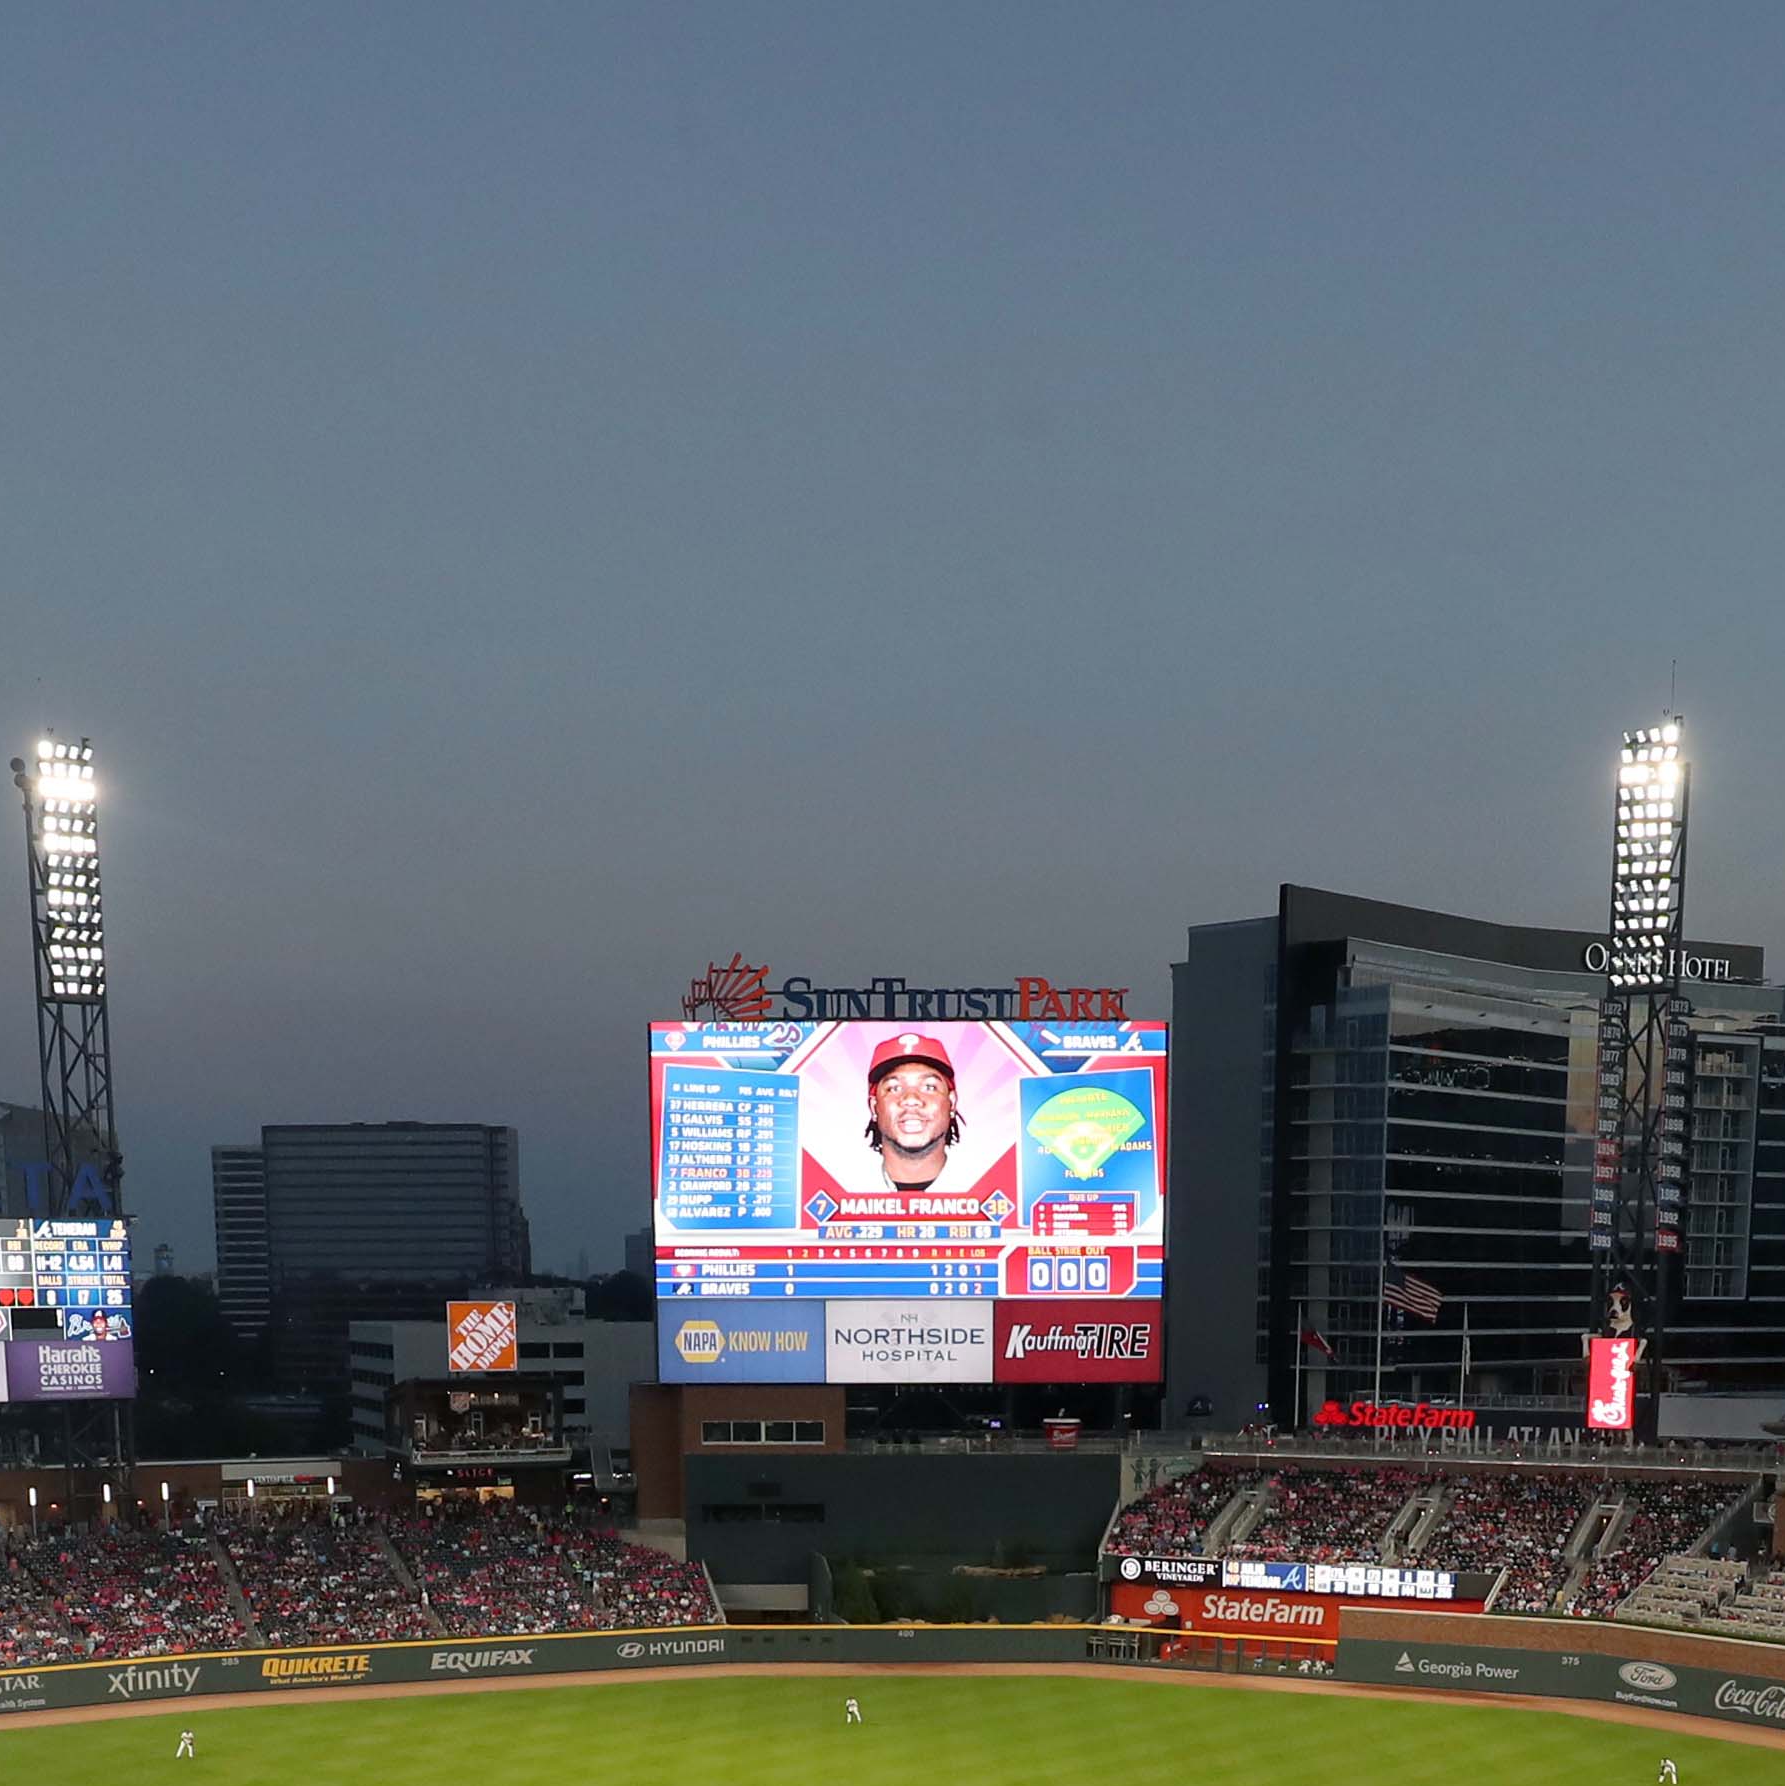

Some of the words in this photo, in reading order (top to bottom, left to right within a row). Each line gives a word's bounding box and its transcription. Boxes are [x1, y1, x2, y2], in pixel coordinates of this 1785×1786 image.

[1669, 949, 1732, 980] HOTEL
[702, 1035, 761, 1048] PHILLIES
[1062, 1035, 1117, 1048] BRAVES
[683, 1101, 733, 1112] HERRERA
[682, 1114, 723, 1125] GALVIS
[681, 1127, 734, 1138] WILLIAMS
[681, 1141, 732, 1152] HOSKINS
[680, 1154, 732, 1165] ALTHERR
[669, 1168, 677, 1178] 7
[680, 1168, 728, 1178] FRANCO
[680, 1181, 732, 1191] CRAWFORD
[679, 1194, 713, 1204] RUPP
[738, 1194, 747, 1204] C
[679, 1207, 731, 1218] ALVAREZ
[738, 1207, 747, 1217] P
[815, 1200, 828, 1215] 7
[840, 1199, 906, 1214] MAIKEL
[909, 1199, 980, 1215] FRANCO
[987, 1199, 1010, 1215] 3B
[826, 1225, 853, 1238] AVG
[855, 1226, 884, 1239] .229
[896, 1225, 915, 1238] HR
[948, 1225, 971, 1238] RBI
[1028, 1246, 1053, 1255] BALL
[1085, 1246, 1106, 1255] OUT
[36, 1255, 62, 1271] 11-12
[68, 1255, 95, 1271] 4.54
[701, 1264, 756, 1276] PHILLIES
[103, 1275, 126, 1286] TOTAL
[1032, 1262, 1050, 1287] 0
[1060, 1262, 1078, 1287] 0
[1088, 1262, 1106, 1287] 0
[700, 1283, 751, 1295] BRAVES
[78, 1290, 89, 1304] 17
[455, 1308, 484, 1337] THE
[450, 1302, 515, 1371] HOME
[683, 1332, 717, 1352] NAPA
[729, 1331, 771, 1352] KNOW
[775, 1331, 809, 1352] HOW
[835, 1328, 985, 1345] NORTHSIDE
[1005, 1325, 1099, 1359] Kauffman
[1075, 1324, 1151, 1358] TIRE
[38, 1346, 101, 1363] Harrah's
[475, 1326, 516, 1371] DEPOT
[862, 1350, 958, 1361] HOSPITAL
[40, 1364, 102, 1374] CHEROKEE
[40, 1375, 102, 1385] CASINOS
[1144, 1560, 1216, 1575] BERINGER
[1156, 1573, 1204, 1583] VINEYARDS
[649, 1639, 725, 1655] HYUNDAI
[261, 1654, 371, 1678] QUIKRETE
[430, 1649, 535, 1672] EQUIFAX
[1561, 1656, 1580, 1666] 375
[1418, 1659, 1472, 1678] Georgia
[1476, 1663, 1519, 1679] Power
[1630, 1667, 1663, 1685] Ford
[108, 1663, 201, 1698] xfinity
[17, 1696, 45, 1710] System
